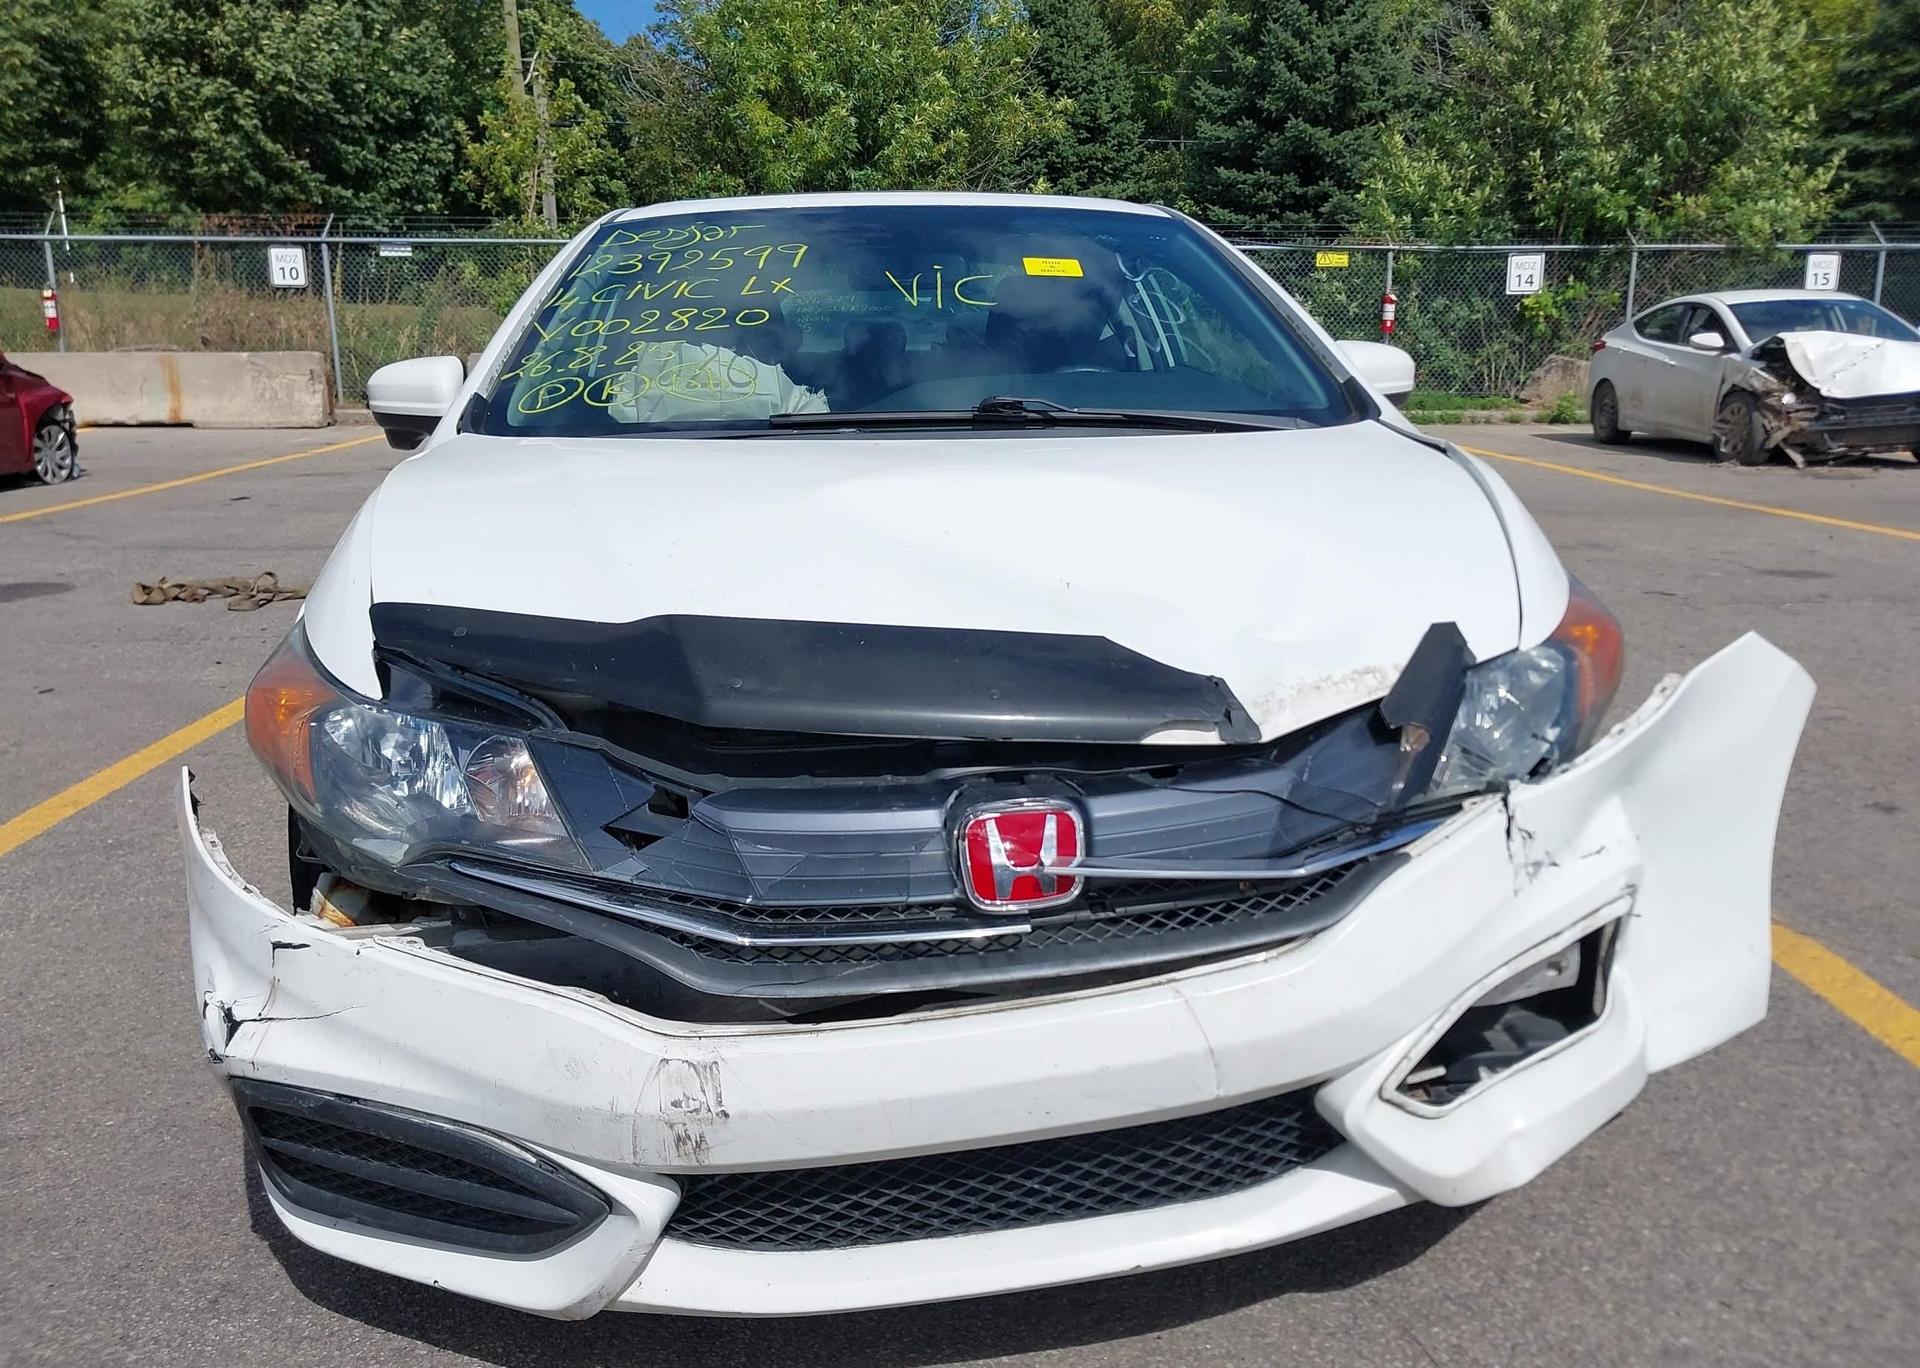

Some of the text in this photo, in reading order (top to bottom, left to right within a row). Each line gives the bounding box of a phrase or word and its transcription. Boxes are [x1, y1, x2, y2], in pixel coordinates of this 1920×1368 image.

[279, 266, 299, 281] 10
[1515, 273, 1535, 287] 14
[1812, 272, 1831, 286] 15
[740, 275, 796, 297] LX
